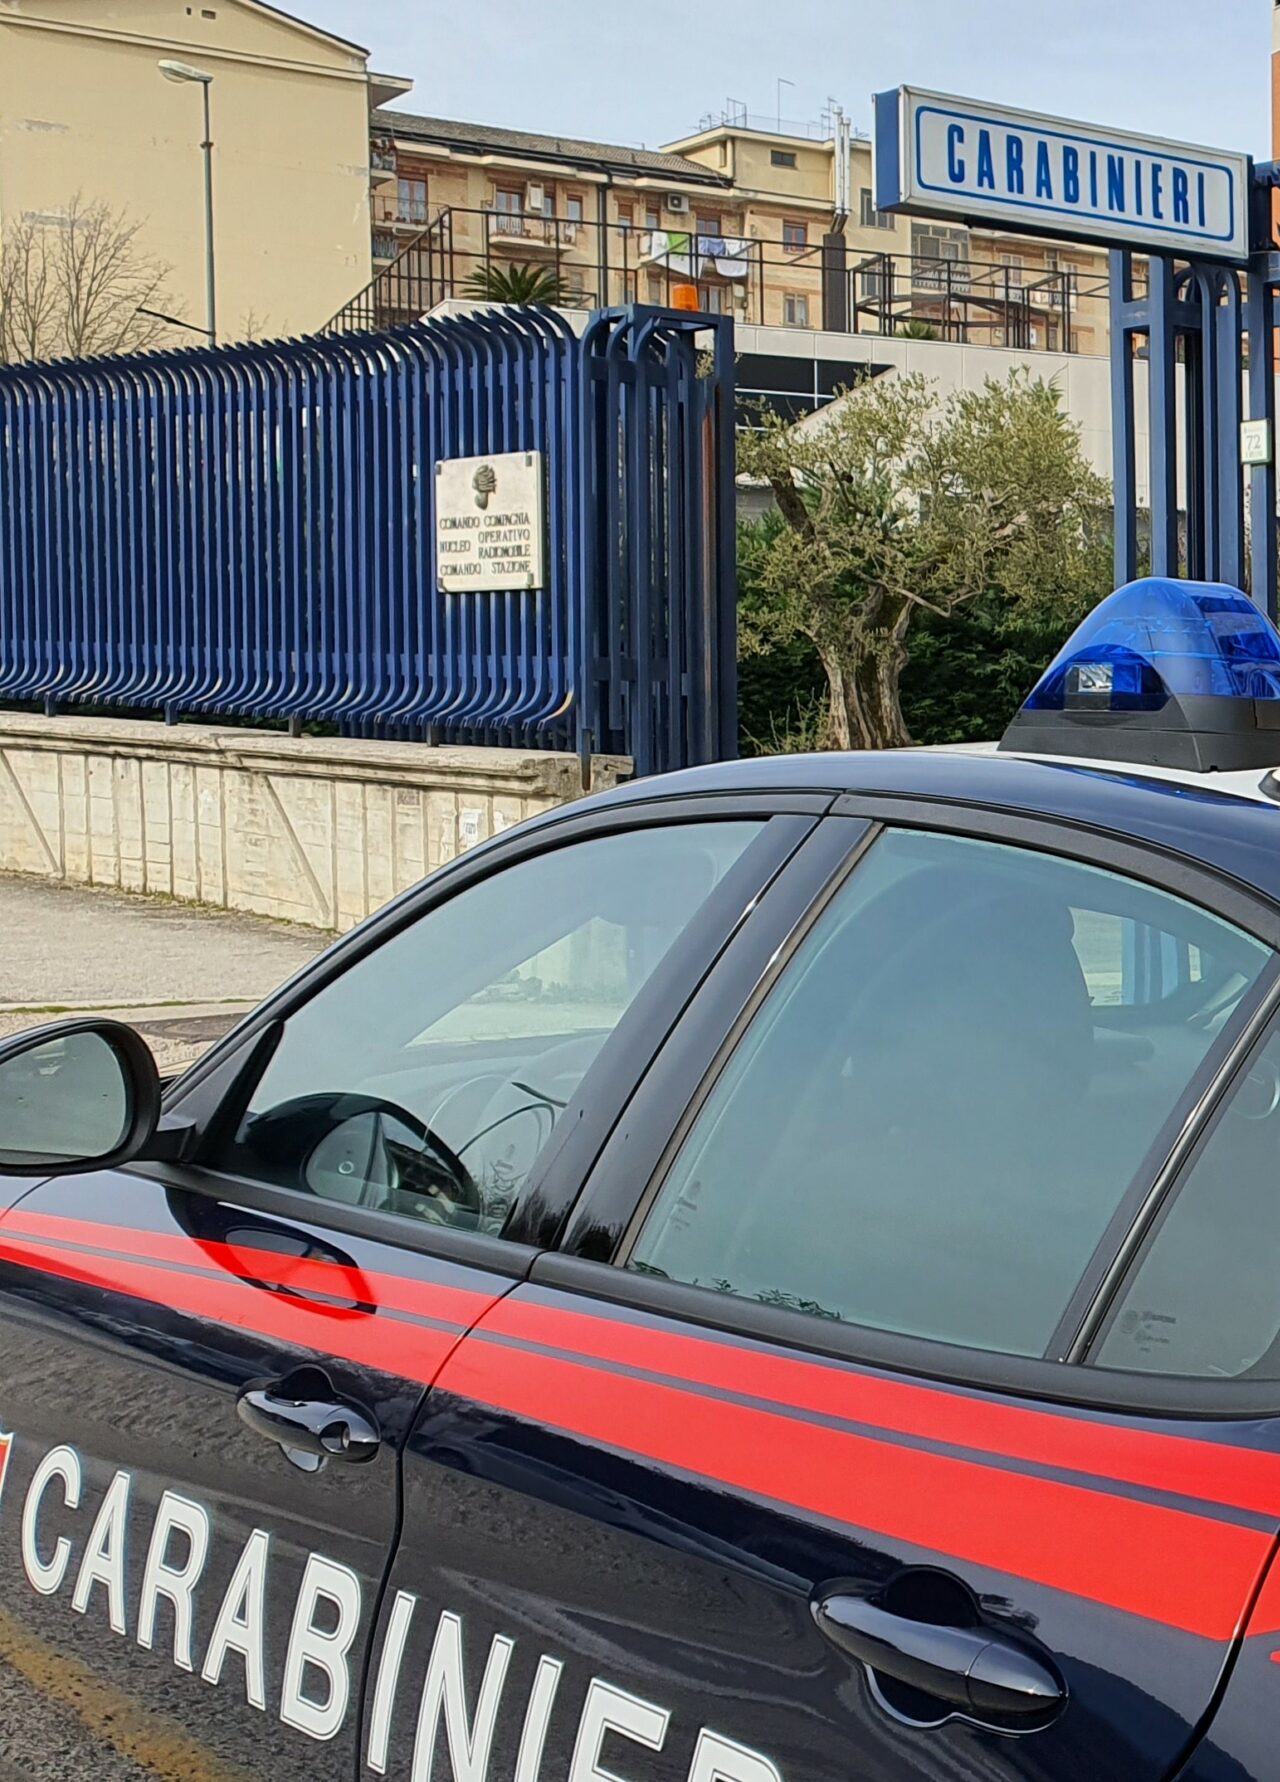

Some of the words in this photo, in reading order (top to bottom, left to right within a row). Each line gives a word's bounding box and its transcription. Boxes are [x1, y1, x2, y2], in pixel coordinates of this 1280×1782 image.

[946, 123, 1206, 228] CARABINIERI
[1246, 434, 1262, 451] 72
[439, 516, 480, 530] COMANDO
[484, 512, 531, 528] COMPAGNIA
[478, 529, 531, 544] OPERATIVO
[439, 540, 471, 554] NUCLEO
[440, 563, 482, 576] COMANDO
[491, 561, 531, 574] STAZIONE
